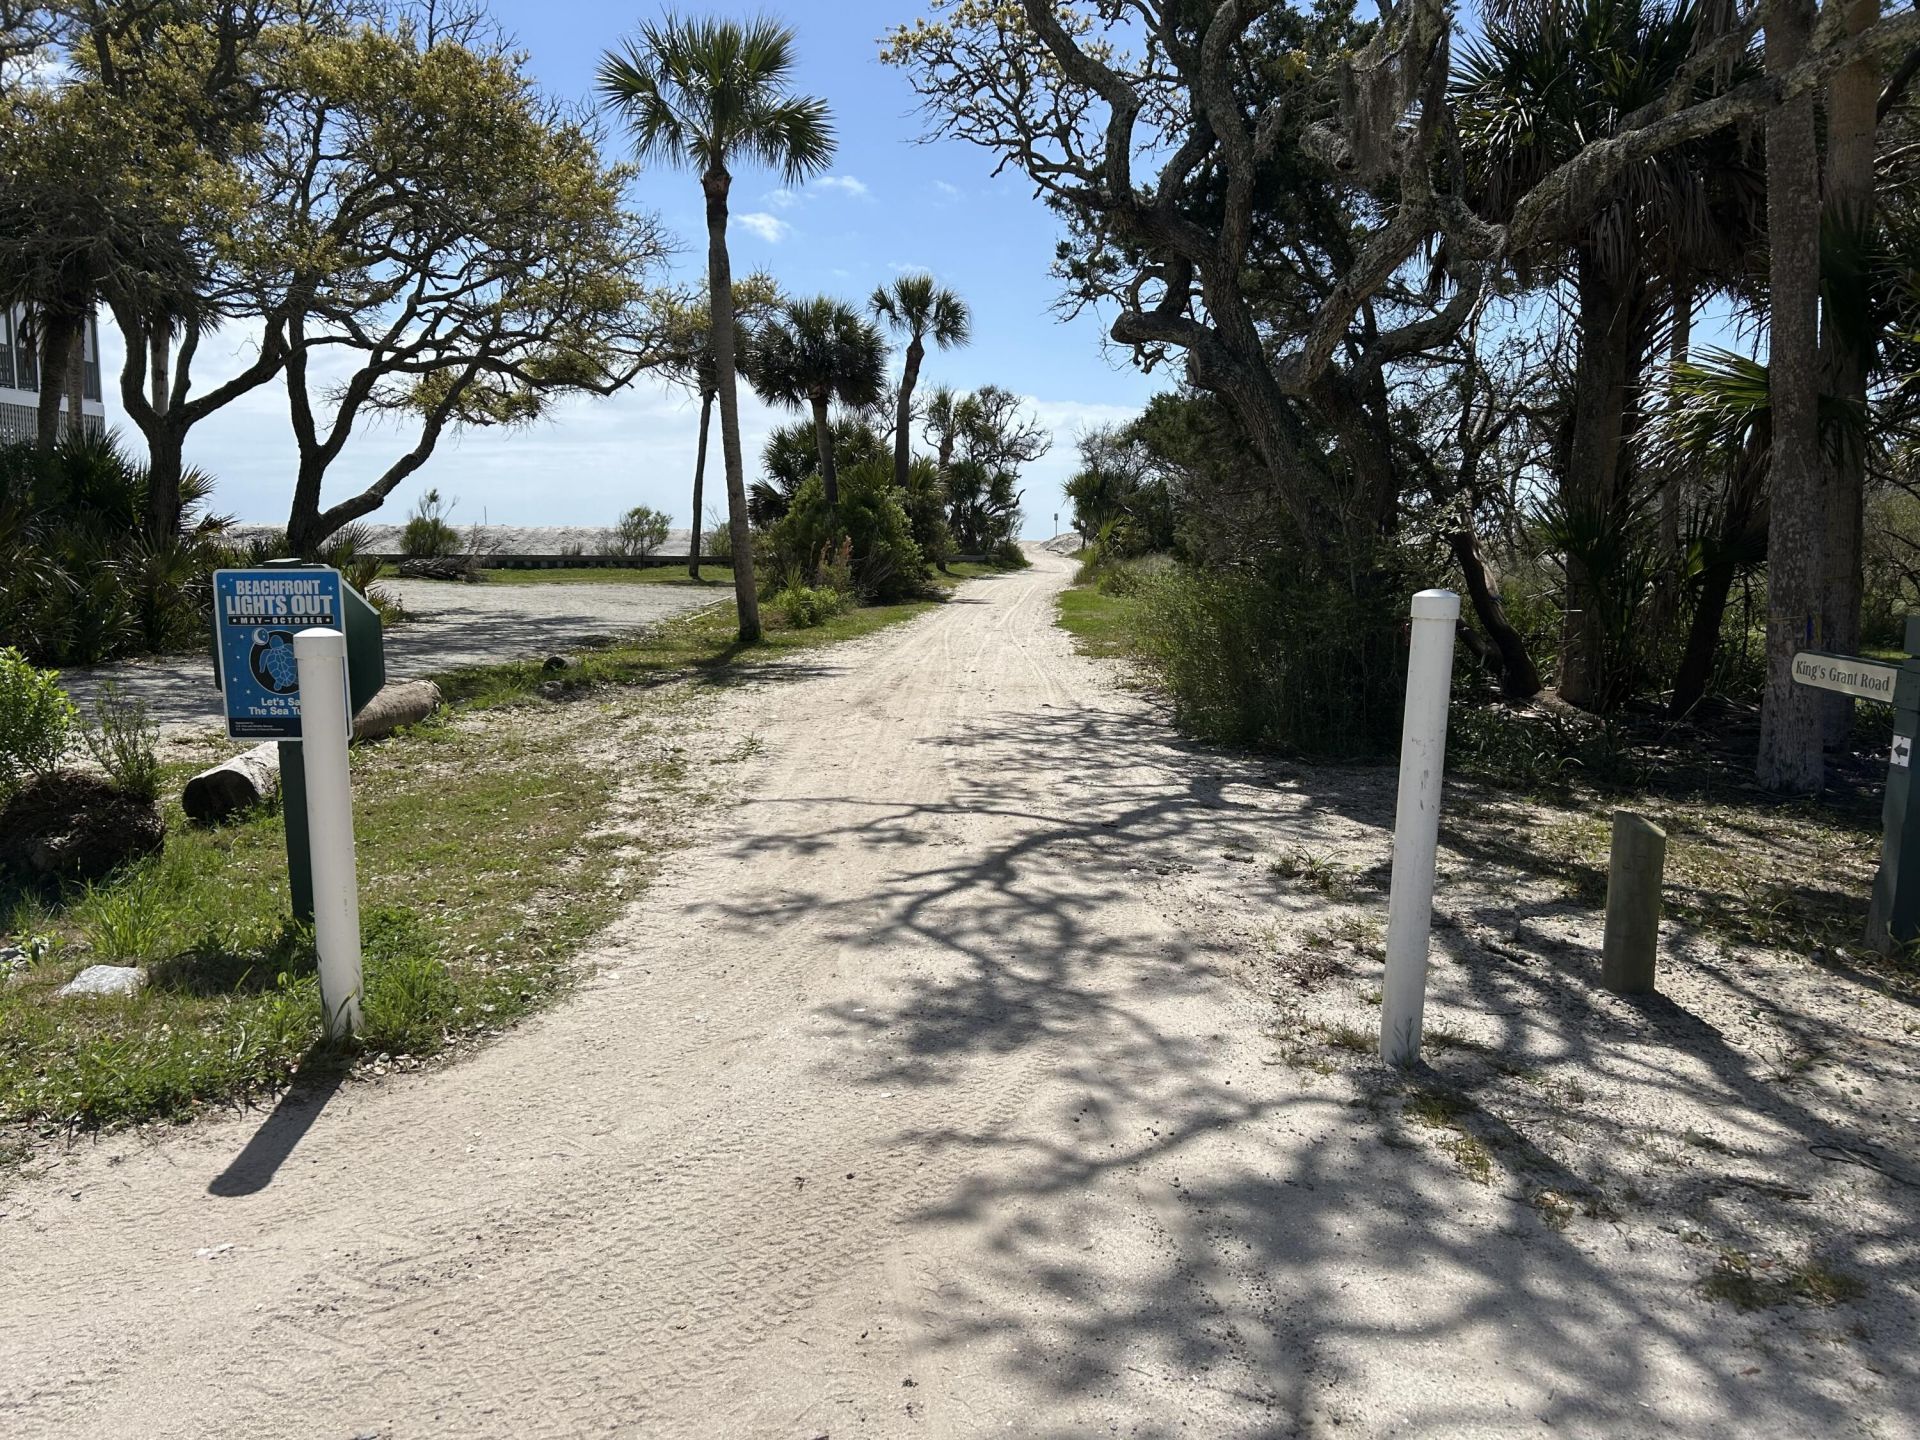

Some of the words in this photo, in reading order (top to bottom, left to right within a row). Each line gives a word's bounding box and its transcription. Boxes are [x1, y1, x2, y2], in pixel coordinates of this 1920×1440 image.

[236, 580, 320, 594] BEACHFRONT
[226, 595, 287, 614] LIGHTS
[291, 595, 333, 614] OUT
[1796, 660, 1826, 681] King's
[1829, 667, 1858, 685] Grant
[1860, 673, 1890, 691] Road
[261, 697, 285, 706] Let's
[288, 697, 301, 706] Sa
[249, 706, 267, 715] The
[270, 706, 289, 715] Sea
